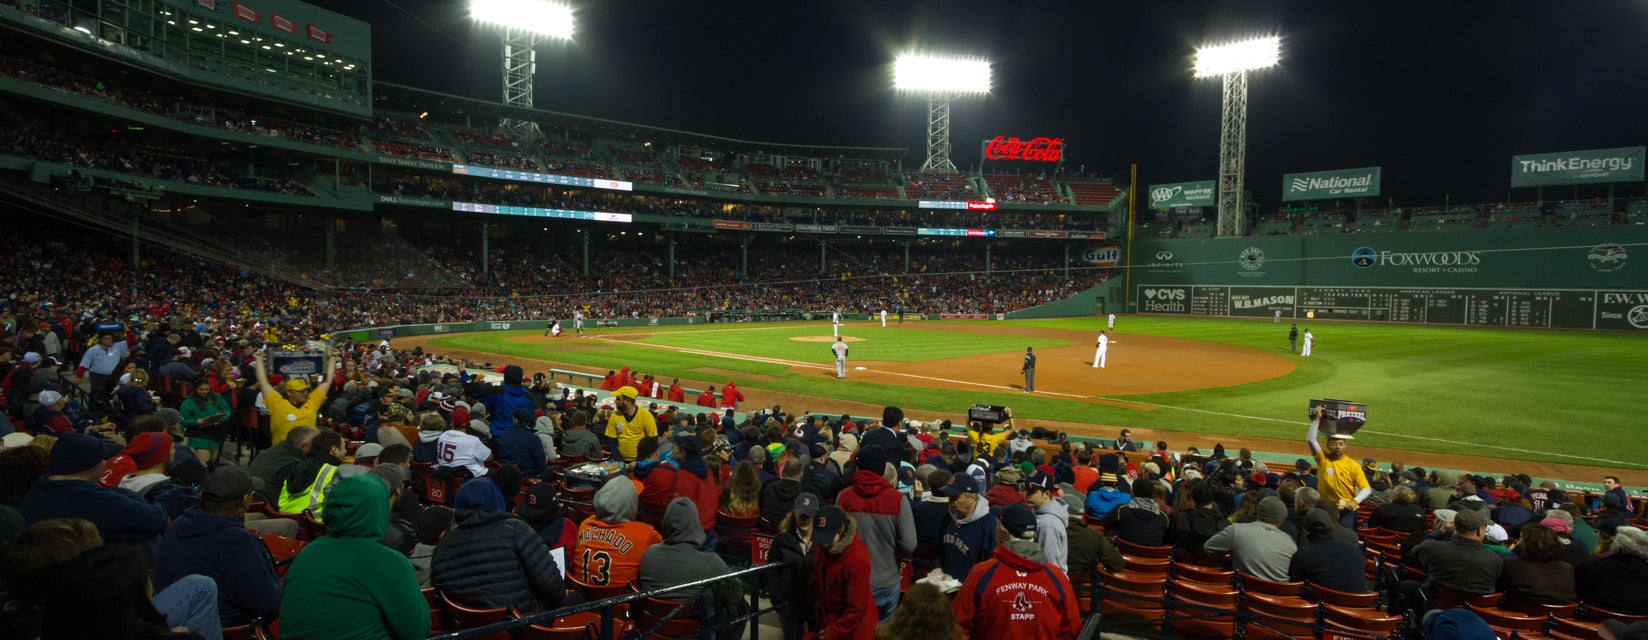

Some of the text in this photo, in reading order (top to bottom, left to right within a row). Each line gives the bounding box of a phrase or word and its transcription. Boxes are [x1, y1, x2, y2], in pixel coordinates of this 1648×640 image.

[986, 136, 1064, 162] Coca-Cola
[399, 159, 417, 167] STREET
[1520, 157, 1632, 173] ThinkEnergy
[1308, 174, 1372, 190] National
[1154, 189, 1171, 200] AAA
[1183, 188, 1212, 196] MAPFRE
[1085, 249, 1119, 261] Gulf
[1380, 251, 1480, 266] FOXWOODS
[1157, 288, 1186, 300] CVS
[1603, 293, 1635, 304] F.W.
[1145, 300, 1185, 312] Health
[1601, 311, 1623, 319] Since
[1337, 410, 1366, 421] PRETZEL
[438, 442, 457, 463] 15
[432, 488, 442, 498] 20
[578, 526, 633, 555] MACHADO
[581, 548, 613, 586] 13
[995, 582, 1050, 597] FENWAY PARK
